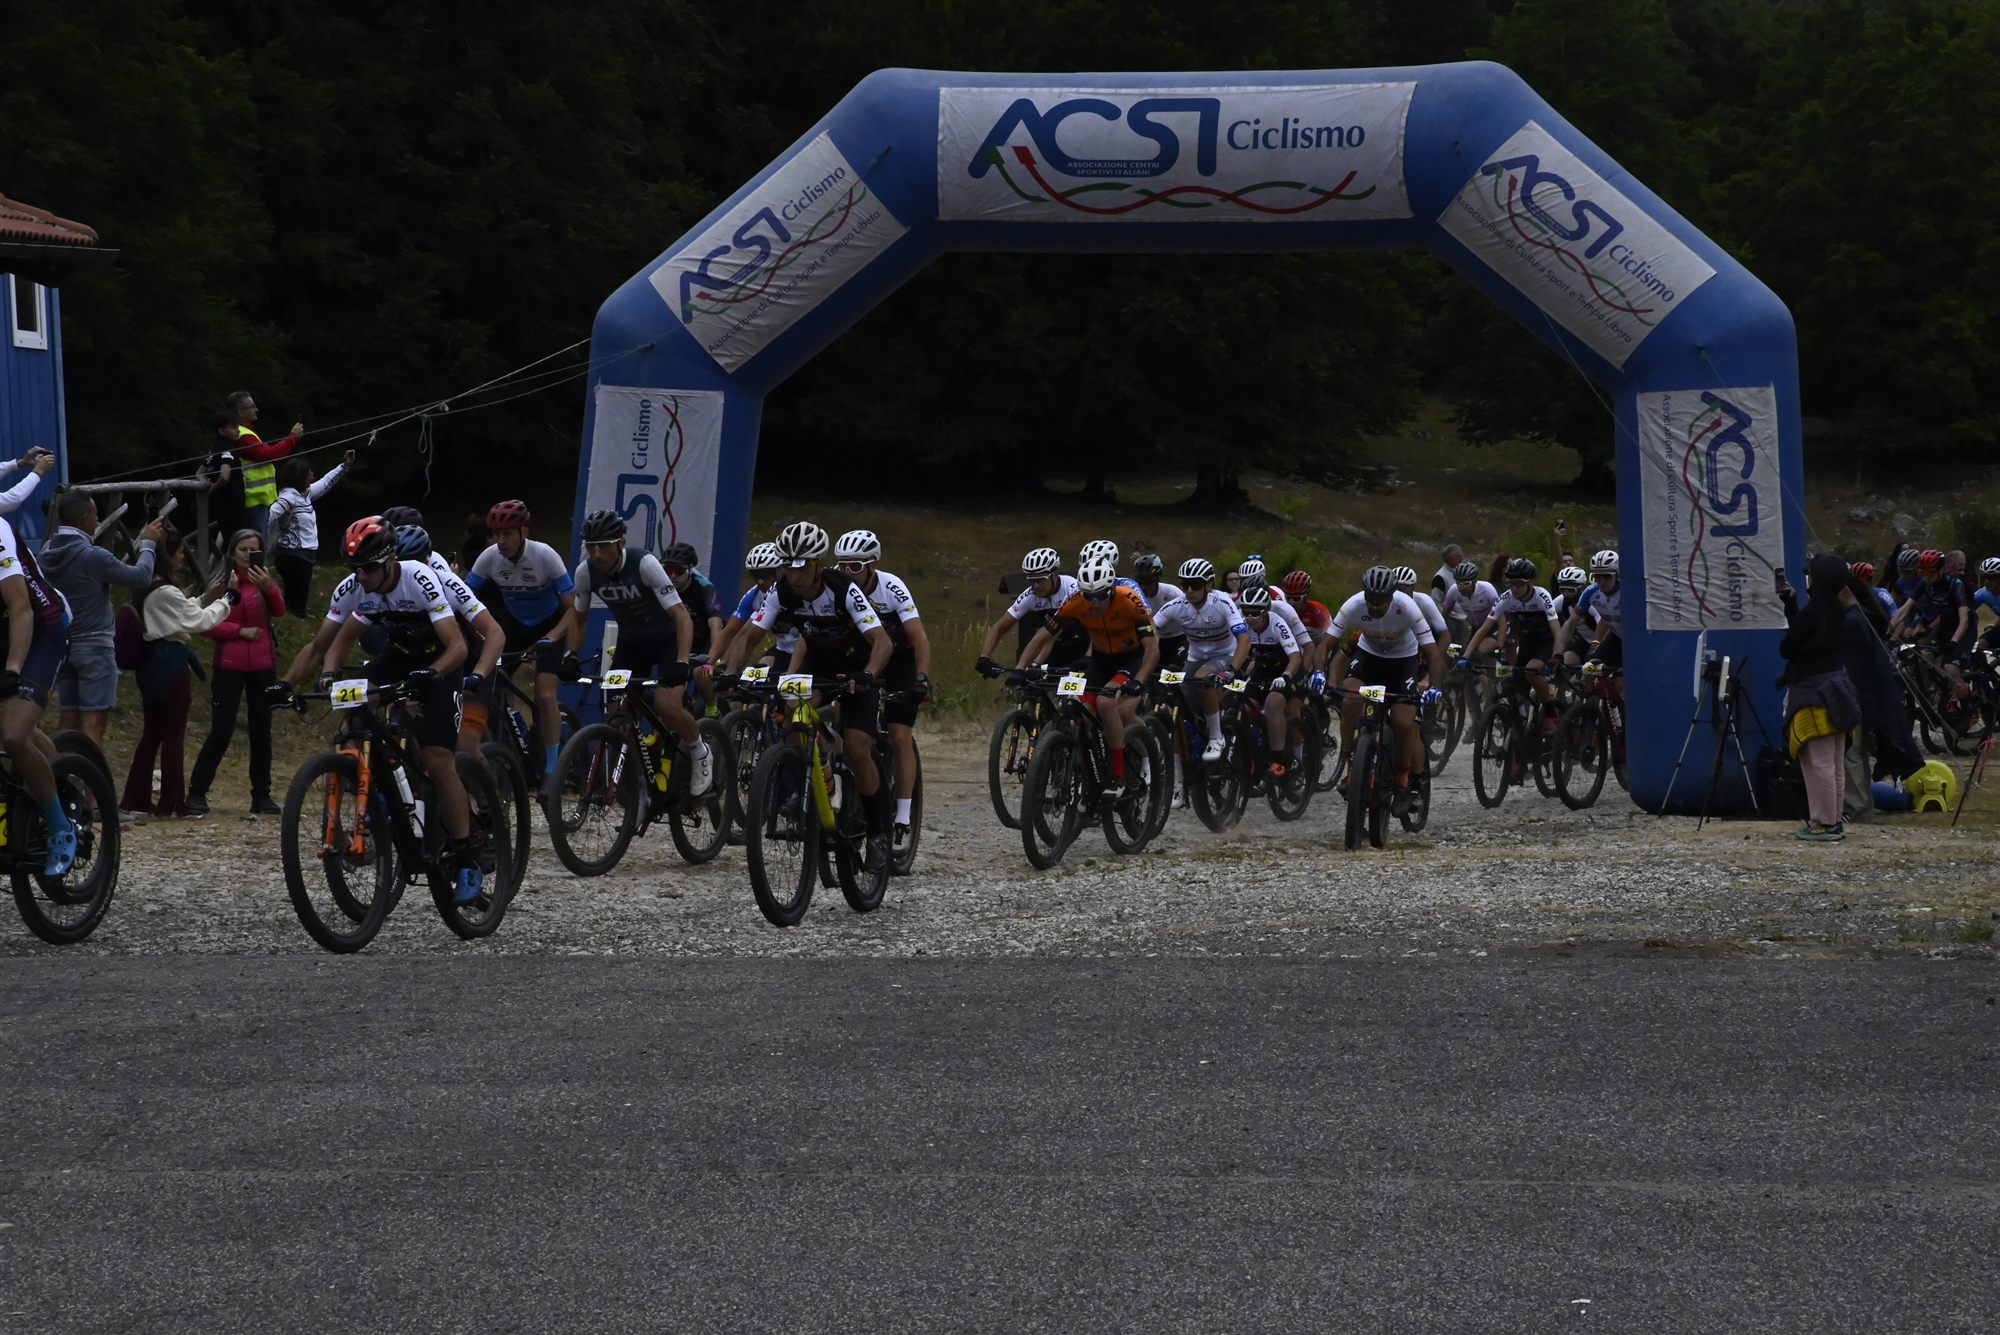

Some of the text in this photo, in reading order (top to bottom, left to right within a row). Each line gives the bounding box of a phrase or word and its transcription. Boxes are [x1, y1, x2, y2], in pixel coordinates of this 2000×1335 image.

[968, 97, 1365, 179] ACSI Ciclismo
[1066, 160, 1160, 169] ASSOCIAZIONE CENTRI
[1076, 168, 1151, 176] SPORTIVI ITALIANI
[1481, 154, 1624, 259] ACSI
[680, 166, 846, 325] ACSI Ciclismo
[708, 210, 881, 353] Associazione di Cultura Sport e Tempo Libero
[1457, 195, 1506, 242] Associazione
[1505, 237, 1514, 248] di
[1514, 246, 1545, 275] Cultura
[1544, 270, 1570, 290] Sport
[1569, 289, 1577, 298] e
[1576, 294, 1606, 321] Tempo
[1604, 317, 1632, 344] Libero
[1608, 243, 1675, 303] Ciclismo
[632, 399, 652, 470] Ciclismo
[1662, 394, 1673, 458] Associazione
[1666, 471, 1678, 512] Cultura
[1701, 391, 1759, 623] ACSI Ciclismo
[1668, 513, 1680, 538] Sport
[1670, 539, 1678, 551] e
[1669, 552, 1681, 586] Tempo
[29, 580, 51, 607] SPORT
[413, 570, 440, 601] LEDA
[444, 579, 471, 604] LEDA
[885, 581, 909, 604] LEDA
[849, 587, 868, 613] EDA
[1540, 592, 1553, 610] LEDA
[1673, 587, 1683, 623] Libero
[1275, 622, 1290, 640] LEDA
[609, 675, 622, 685] 62
[748, 669, 762, 679] 38
[1064, 681, 1078, 691] 65
[1165, 673, 1178, 682] 25
[340, 688, 357, 703] 21
[786, 682, 801, 694] 51
[1365, 689, 1379, 698] 36
